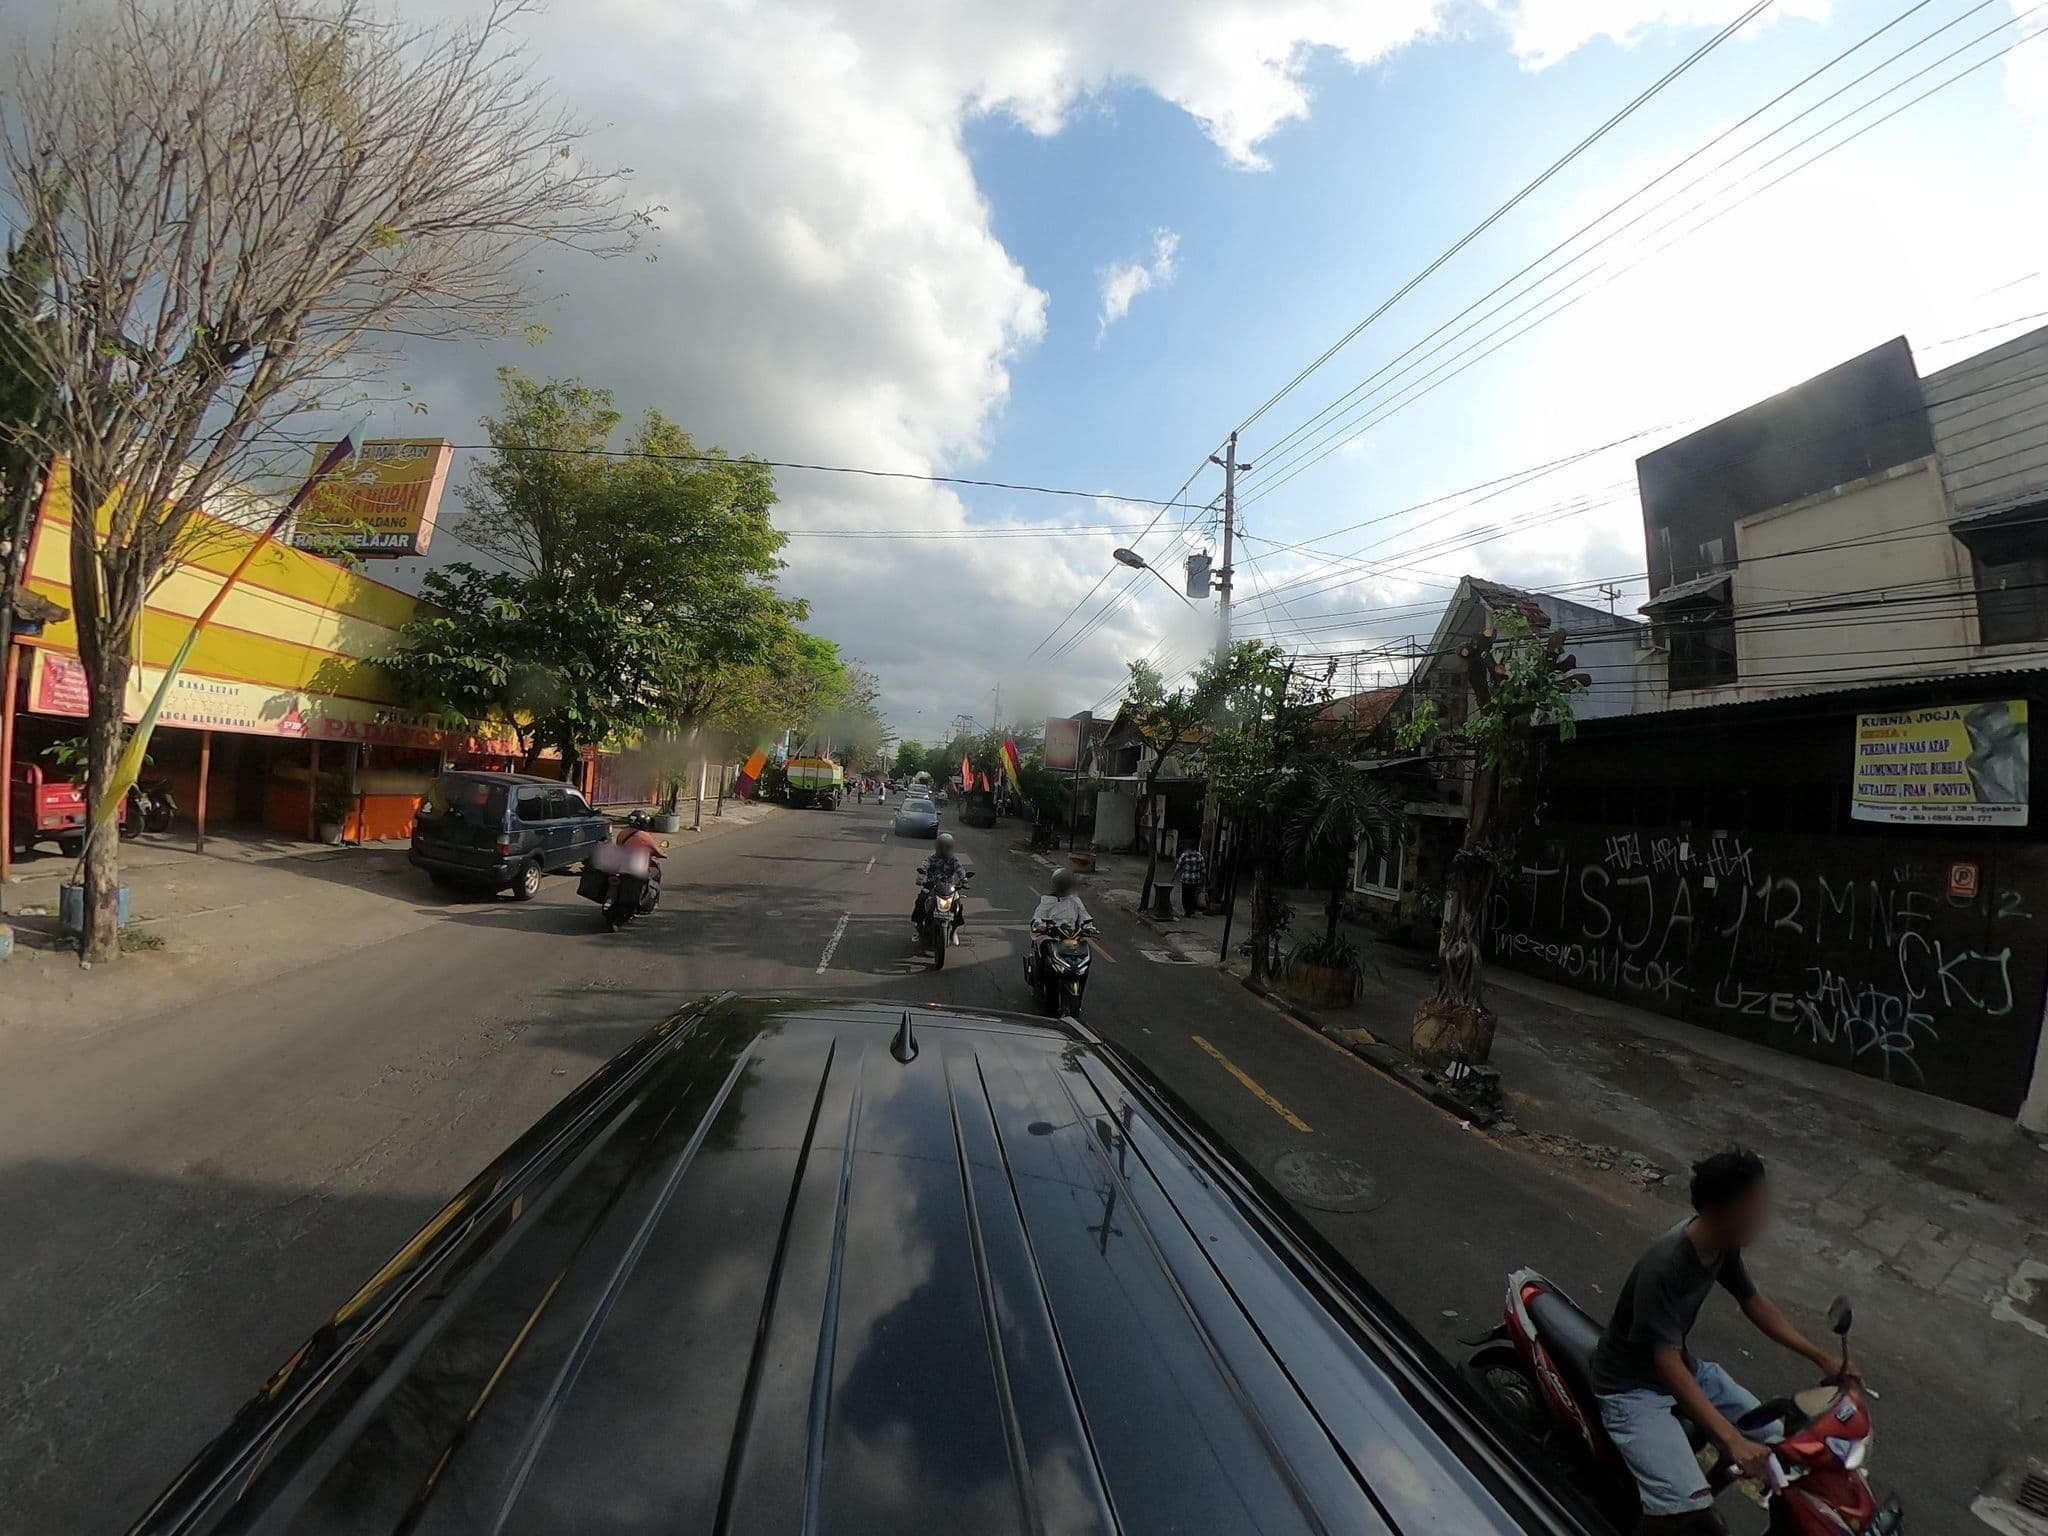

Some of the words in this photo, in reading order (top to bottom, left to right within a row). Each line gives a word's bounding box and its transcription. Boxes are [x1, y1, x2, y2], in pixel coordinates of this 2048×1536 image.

[178, 679, 205, 691] RASA
[1861, 716, 1913, 728] KURNIA
[1916, 710, 1961, 723] JOGJA
[1898, 741, 1926, 755] PANAS
